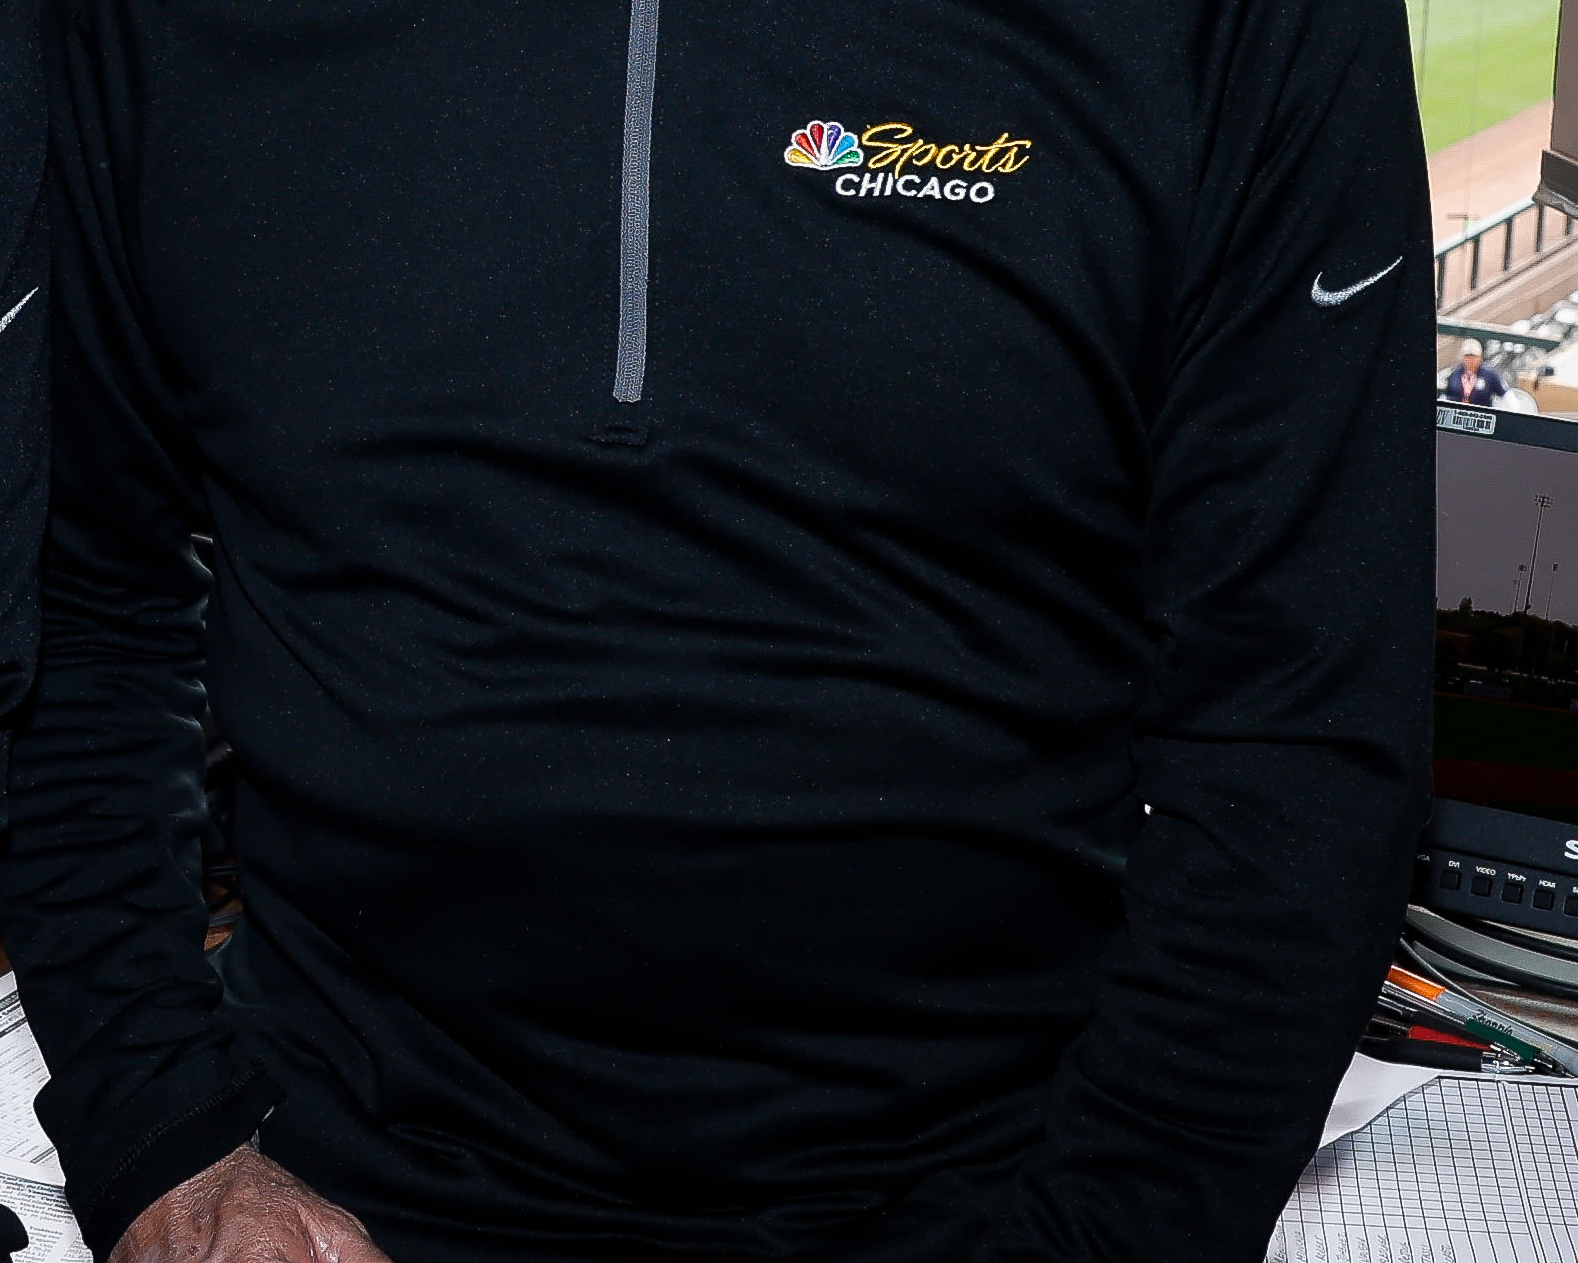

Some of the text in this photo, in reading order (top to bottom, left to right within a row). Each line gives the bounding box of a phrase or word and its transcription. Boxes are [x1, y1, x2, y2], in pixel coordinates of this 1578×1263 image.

[861, 121, 1032, 180] Sports
[835, 172, 995, 203] CHICAGO
[1475, 865, 1496, 876] VIDEO
